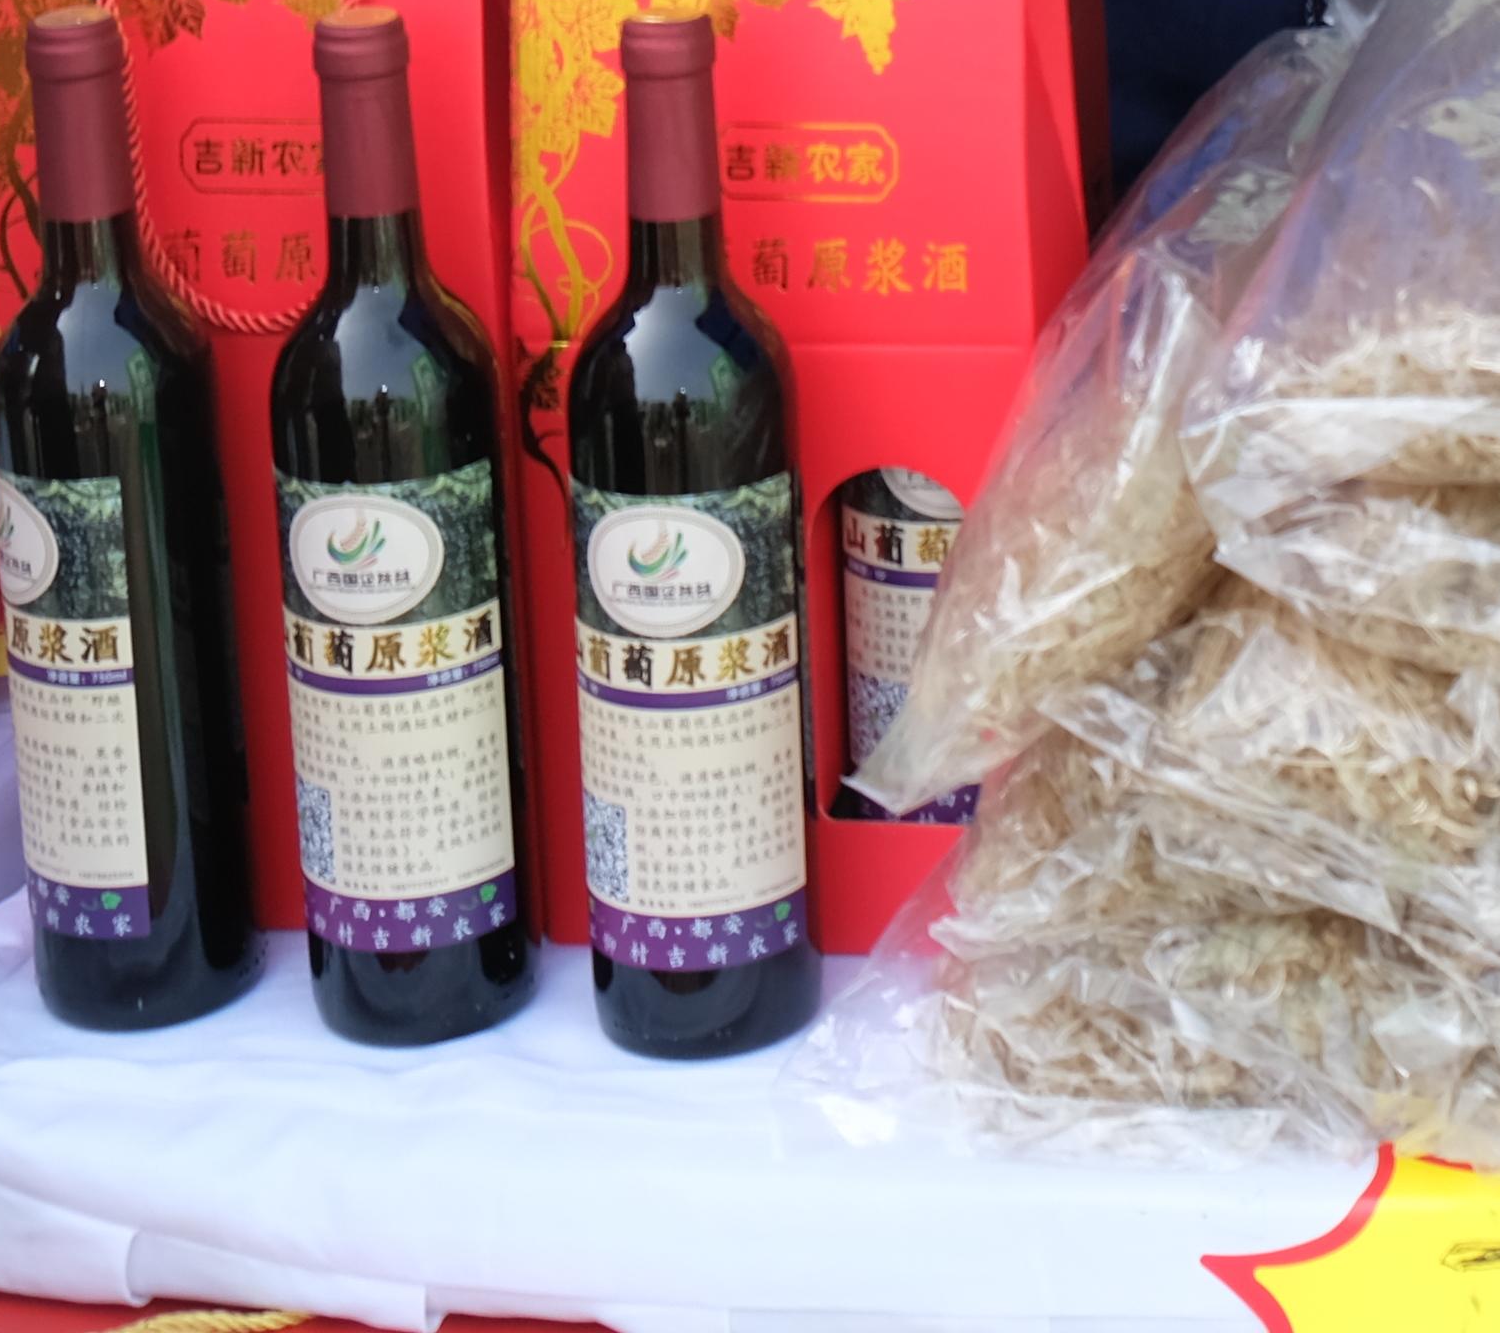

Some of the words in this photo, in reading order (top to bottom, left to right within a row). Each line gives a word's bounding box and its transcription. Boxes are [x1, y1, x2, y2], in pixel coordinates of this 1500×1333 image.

[726, 141, 886, 185] 吉新农家
[11, 616, 119, 664] 原浆酒
